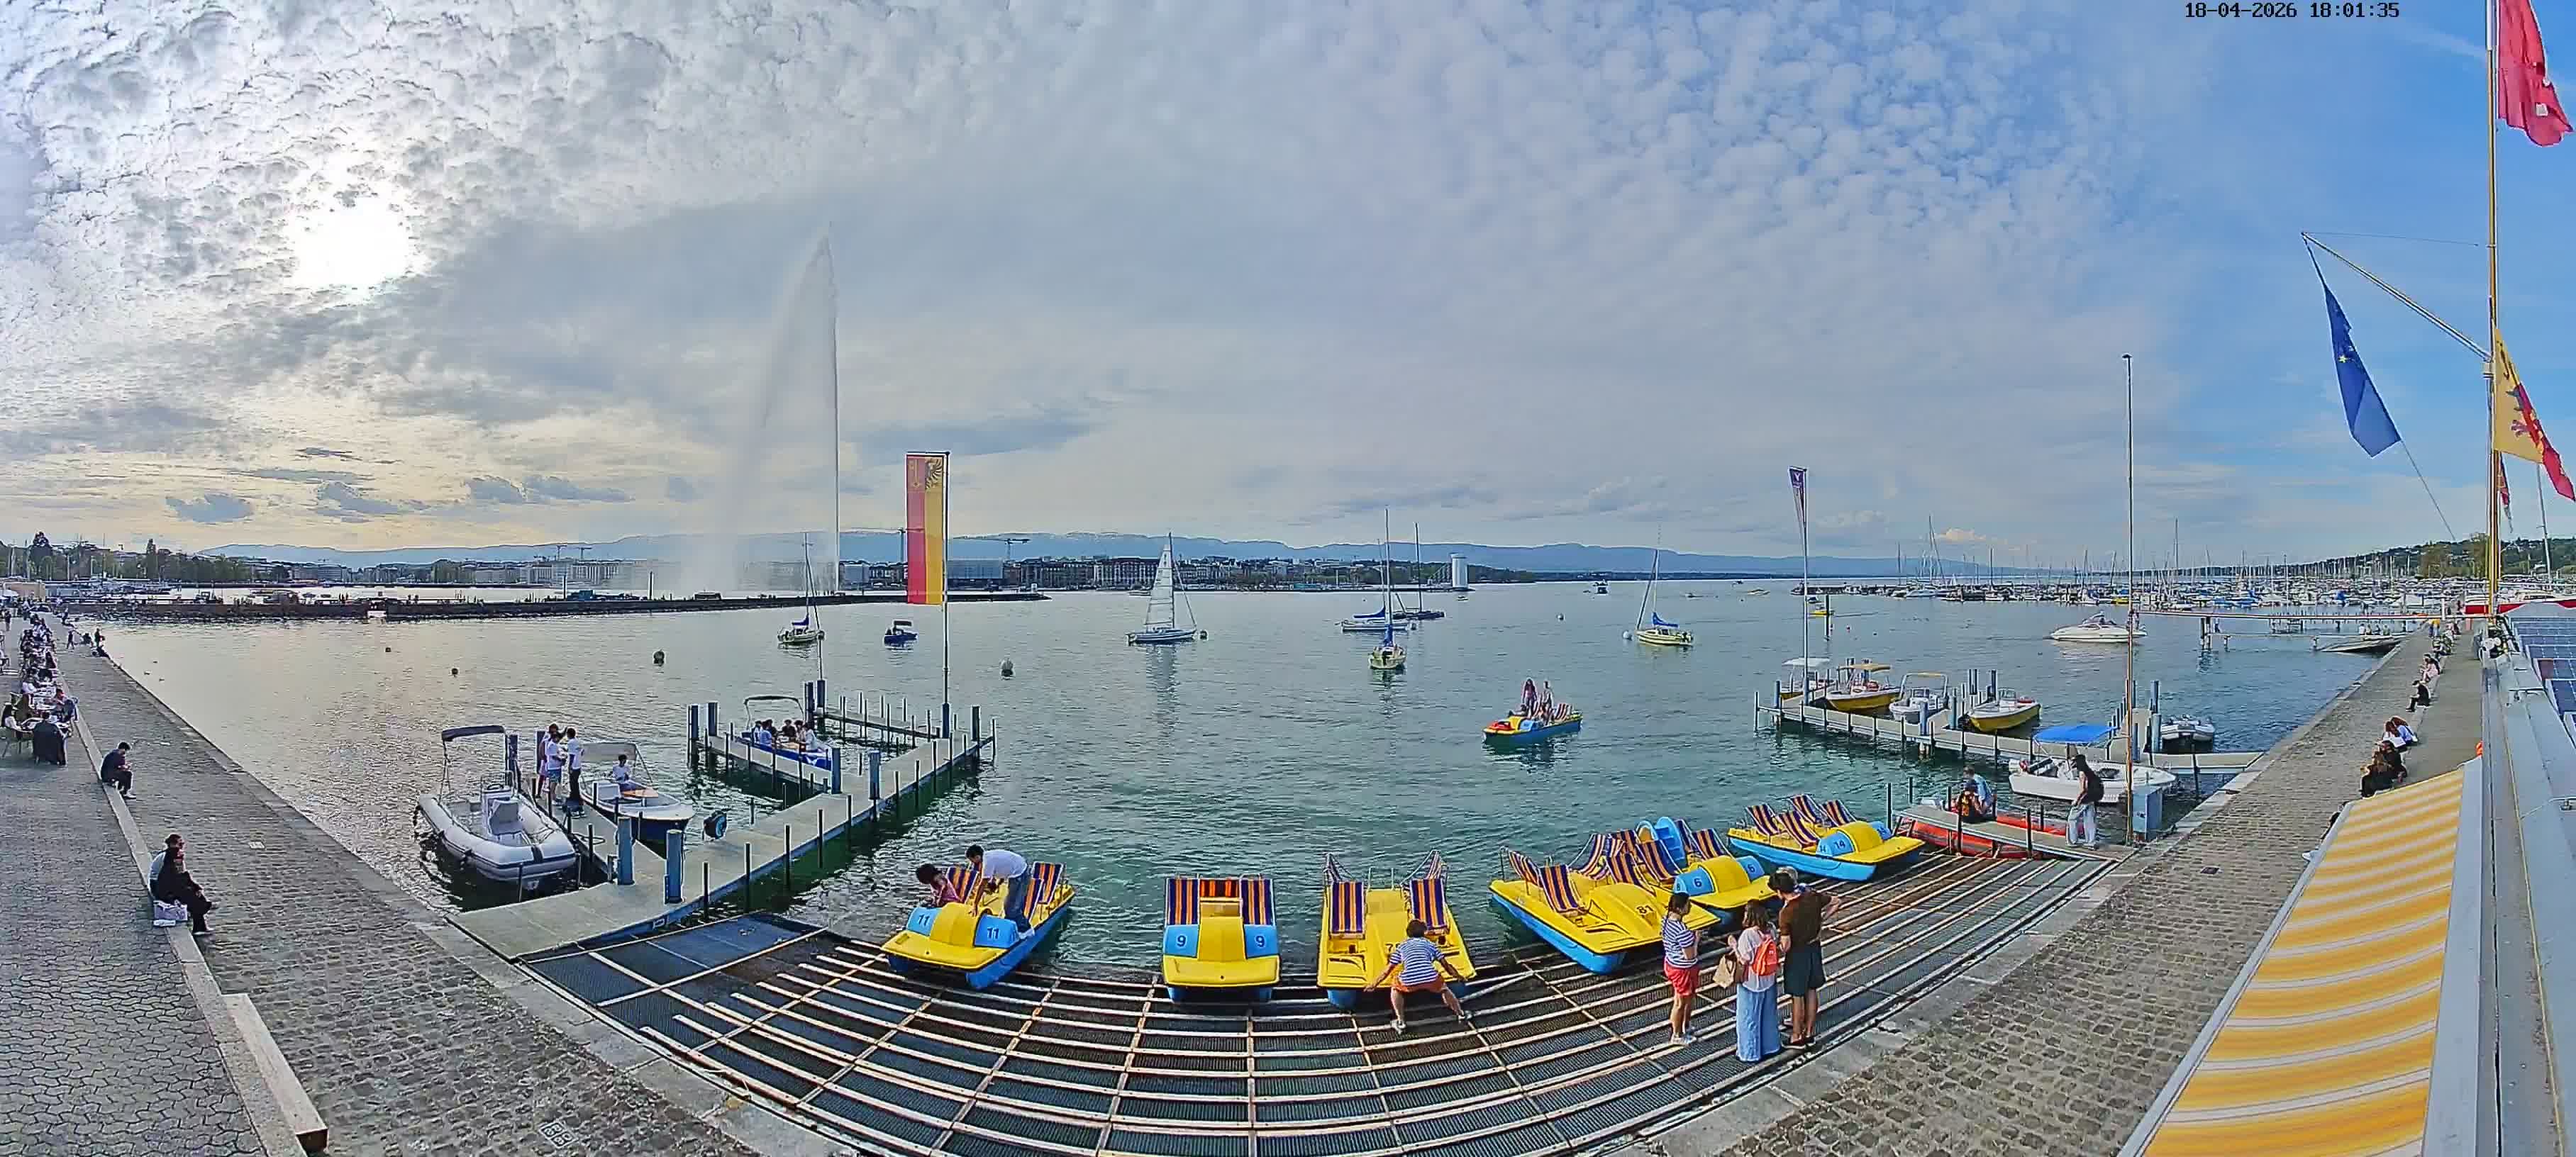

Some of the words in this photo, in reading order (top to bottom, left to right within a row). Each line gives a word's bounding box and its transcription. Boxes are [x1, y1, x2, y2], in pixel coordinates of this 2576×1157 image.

[1694, 878, 1701, 888] 6
[918, 914, 931, 927] 11
[987, 927, 999, 939] 11
[1177, 935, 1187, 947] 9
[1255, 935, 1265, 947] 9
